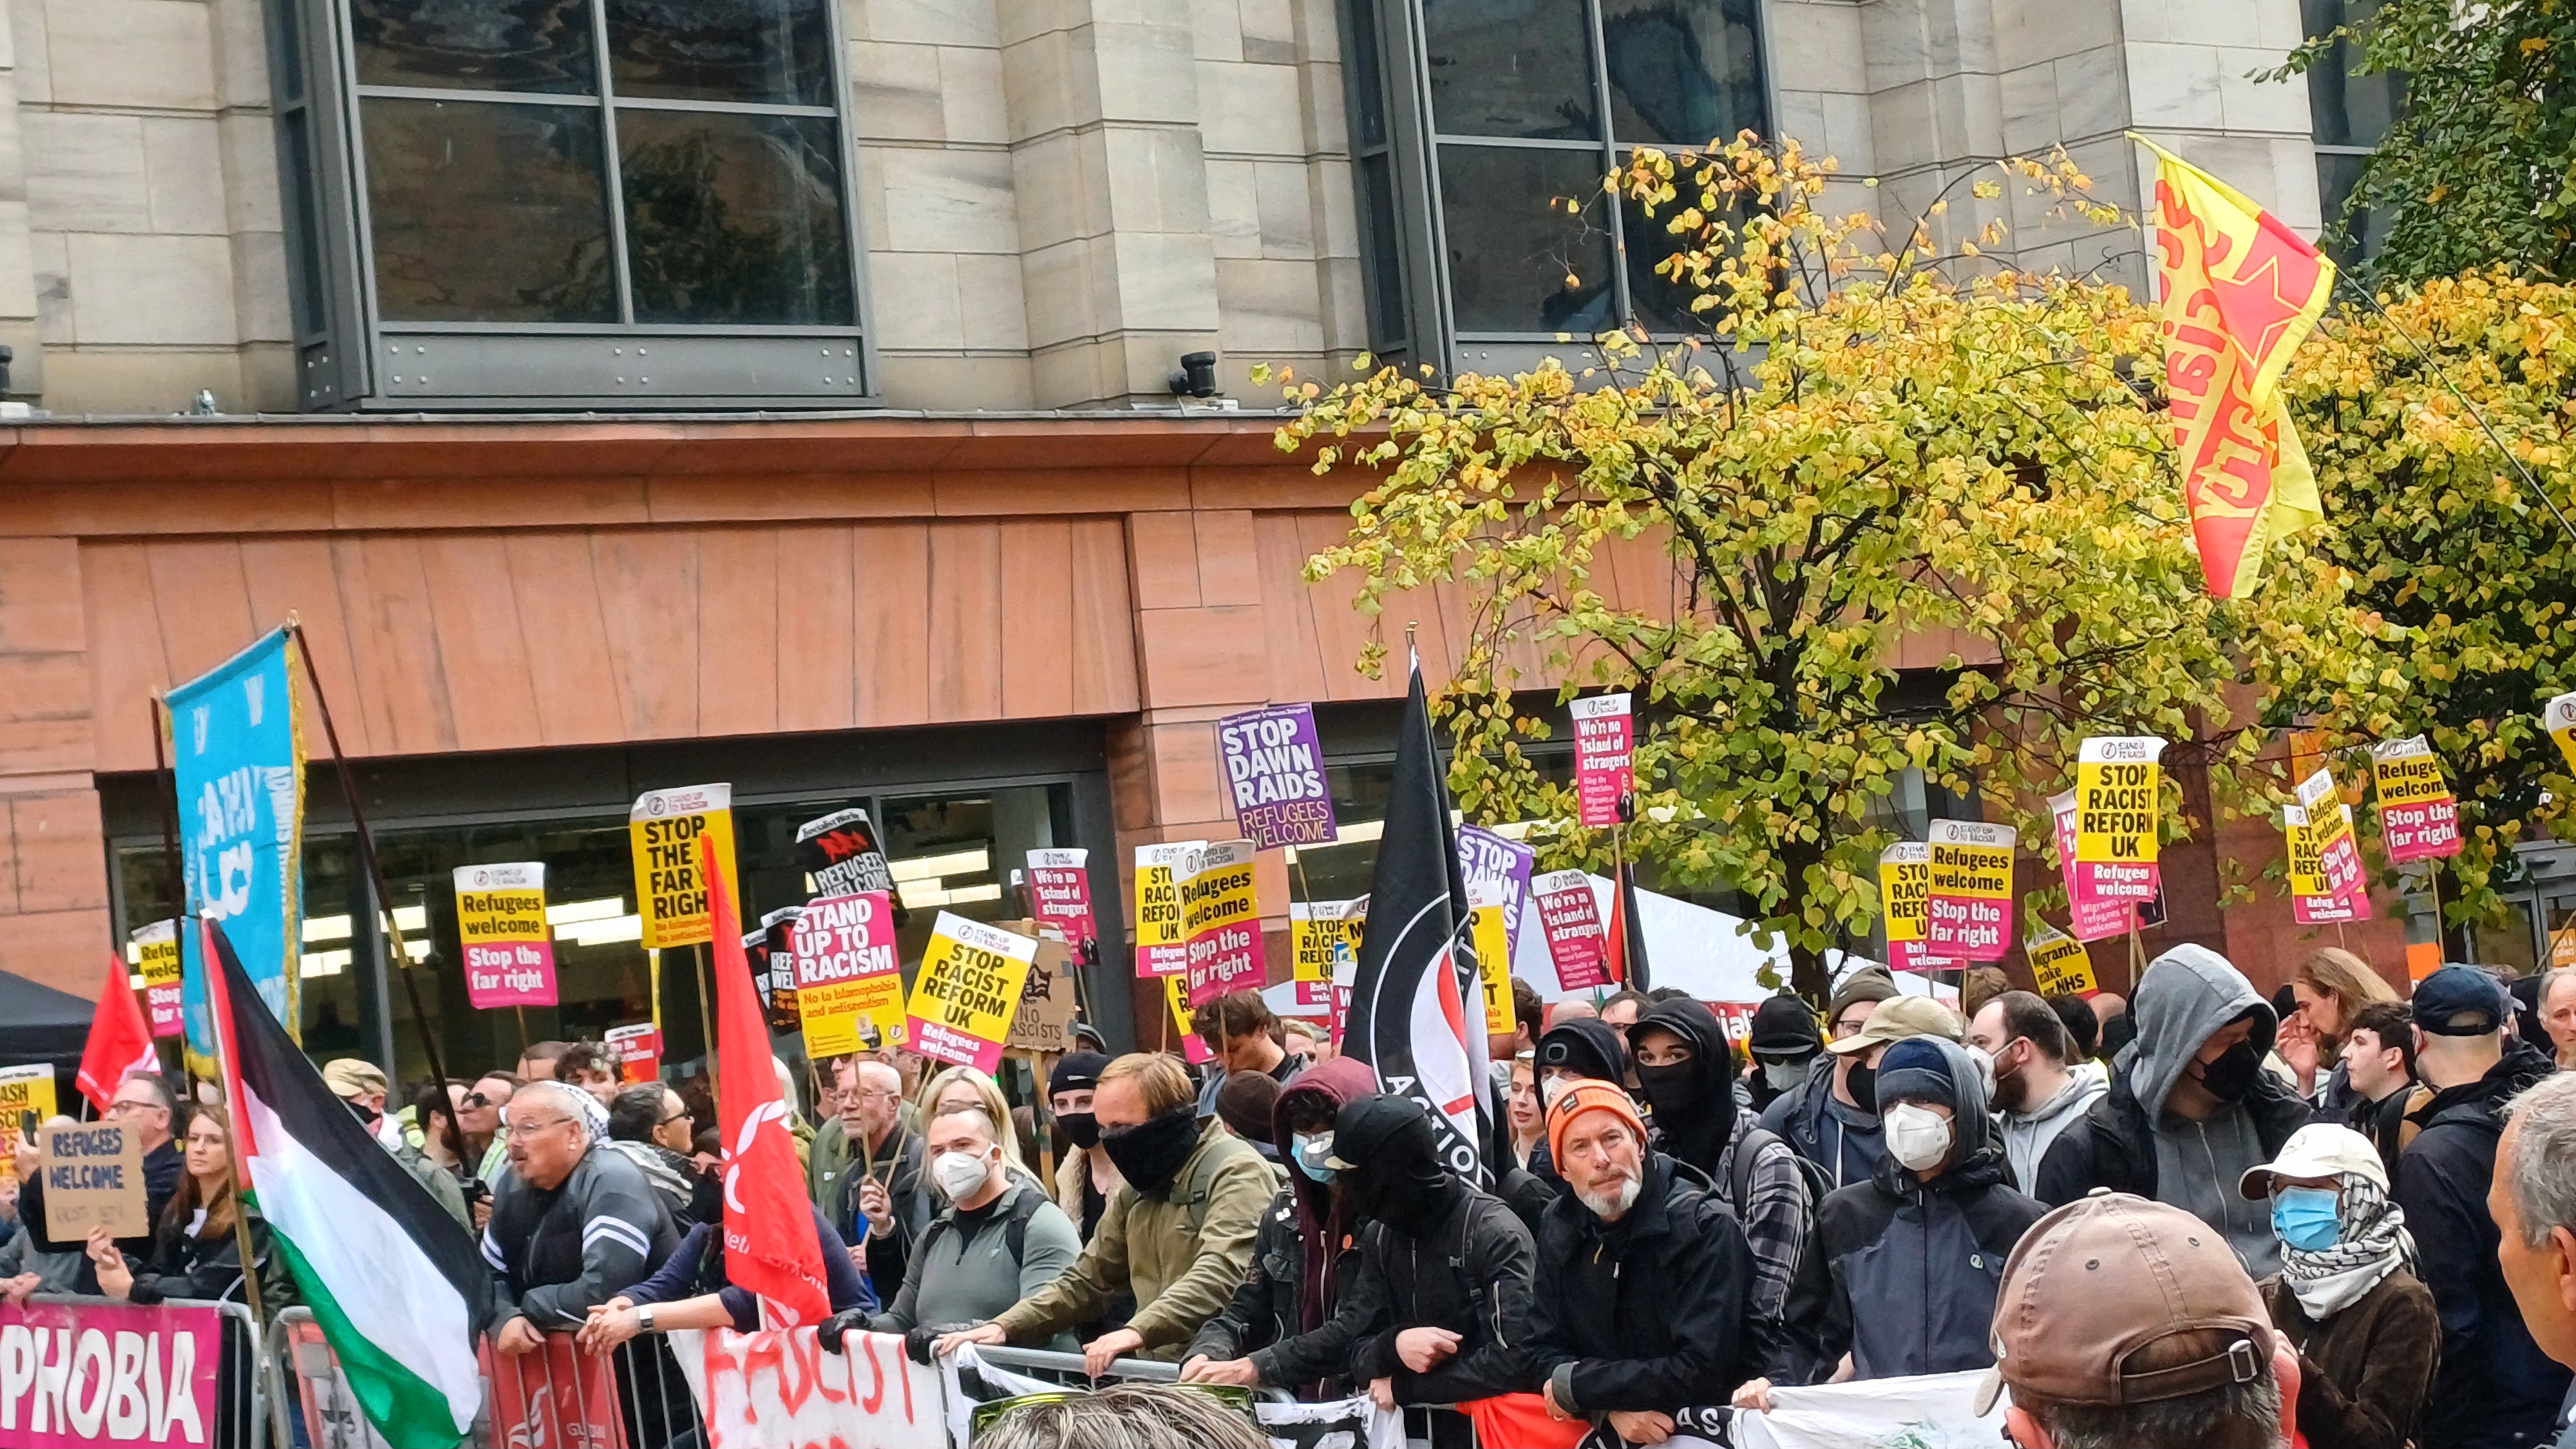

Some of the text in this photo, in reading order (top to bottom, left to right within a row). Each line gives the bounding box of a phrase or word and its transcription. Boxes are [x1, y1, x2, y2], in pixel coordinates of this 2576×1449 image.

[1222, 718, 1298, 755] STOP
[1228, 743, 1314, 782] DAWN
[2099, 765, 2148, 786] STOP
[1235, 770, 1323, 809] RAIDS
[2088, 788, 2151, 810] RACIST
[1242, 801, 1329, 831] REFUGEES
[2083, 812, 2153, 833] REFORM
[2385, 803, 2454, 828] Stop the
[645, 815, 706, 844] STOP
[1244, 820, 1331, 849] WELCOME
[2298, 826, 2312, 842] ST
[2390, 823, 2457, 848] far right
[647, 842, 694, 869] THE
[1459, 835, 1517, 875] STOP
[1934, 846, 2009, 871] Refugees
[2111, 836, 2139, 857] UK
[2295, 843, 2320, 858] RAC
[650, 867, 694, 895] FAR
[815, 851, 886, 891] REFUGEES
[1151, 867, 1172, 885] ST
[1898, 864, 1928, 881] STO
[1934, 870, 2003, 891] welcome
[1145, 886, 1176, 904] RACI
[1182, 871, 1251, 906] Refugees
[1892, 882, 1928, 900] RACI
[2313, 876, 2331, 892] U
[462, 894, 540, 914] Refugees
[653, 891, 710, 920] RIGH
[793, 898, 872, 934] STAND
[1142, 905, 1179, 923] REFO
[1186, 897, 1249, 931] welcome
[1891, 901, 1928, 918] REFO
[1932, 900, 2000, 923] Stop the
[466, 916, 540, 934] welcome
[1915, 919, 1926, 935] U
[1931, 922, 1999, 947] far right
[795, 931, 831, 959] UP
[836, 923, 868, 951] TO
[1189, 929, 1250, 965] Stop the
[1302, 934, 1344, 949] RACIS
[468, 945, 542, 970] Stop the
[799, 945, 893, 983] RACISM
[951, 943, 1005, 972] STOP
[471, 969, 544, 992] far right
[934, 959, 1009, 996] RACIST
[1191, 951, 1253, 990] far right
[2056, 974, 2085, 995] NHS
[804, 992, 818, 1005] No
[923, 977, 1007, 1018] REFORM
[944, 1004, 974, 1029] UK
[1020, 1009, 1040, 1023] NO
[922, 1022, 980, 1052] Refugees
[1010, 1024, 1061, 1040] ASCISTS
[919, 1040, 974, 1065] welcome
[0, 1083, 28, 1103] ASH
[50, 1164, 125, 1190] WELCOME
[0, 1325, 204, 1443] PHOBIA
